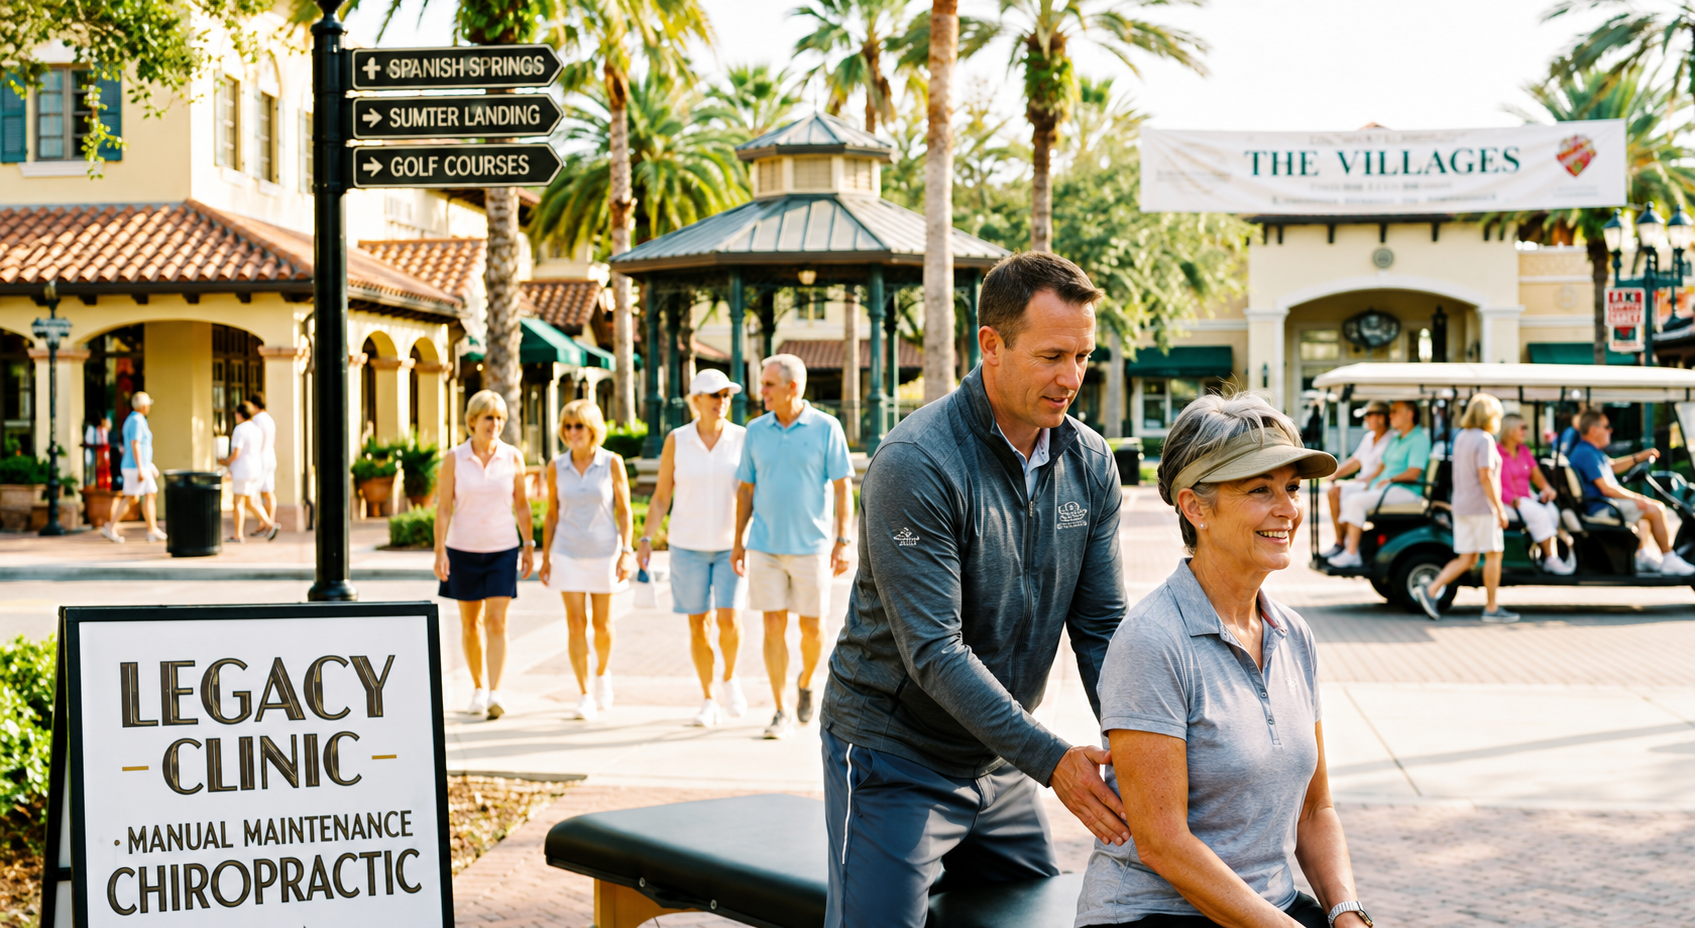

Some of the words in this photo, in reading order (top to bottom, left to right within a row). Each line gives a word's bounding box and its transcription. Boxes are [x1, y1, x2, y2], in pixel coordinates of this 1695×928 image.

[388, 58, 464, 78] SPANISH
[469, 56, 544, 77] SPRINGS
[389, 106, 459, 128] SUMTER
[464, 105, 540, 126] LANDING
[390, 156, 439, 177] GOLF
[444, 154, 530, 176] COURSES
[1244, 150, 1320, 176] THE
[1337, 146, 1521, 175] VILLAGES
[120, 655, 396, 728] LEGACY
[162, 731, 363, 795] CLINIC
[128, 821, 234, 854] MANUAL
[243, 810, 413, 847] MAINTENANCE
[107, 848, 423, 916] CHIROPRACTIC
